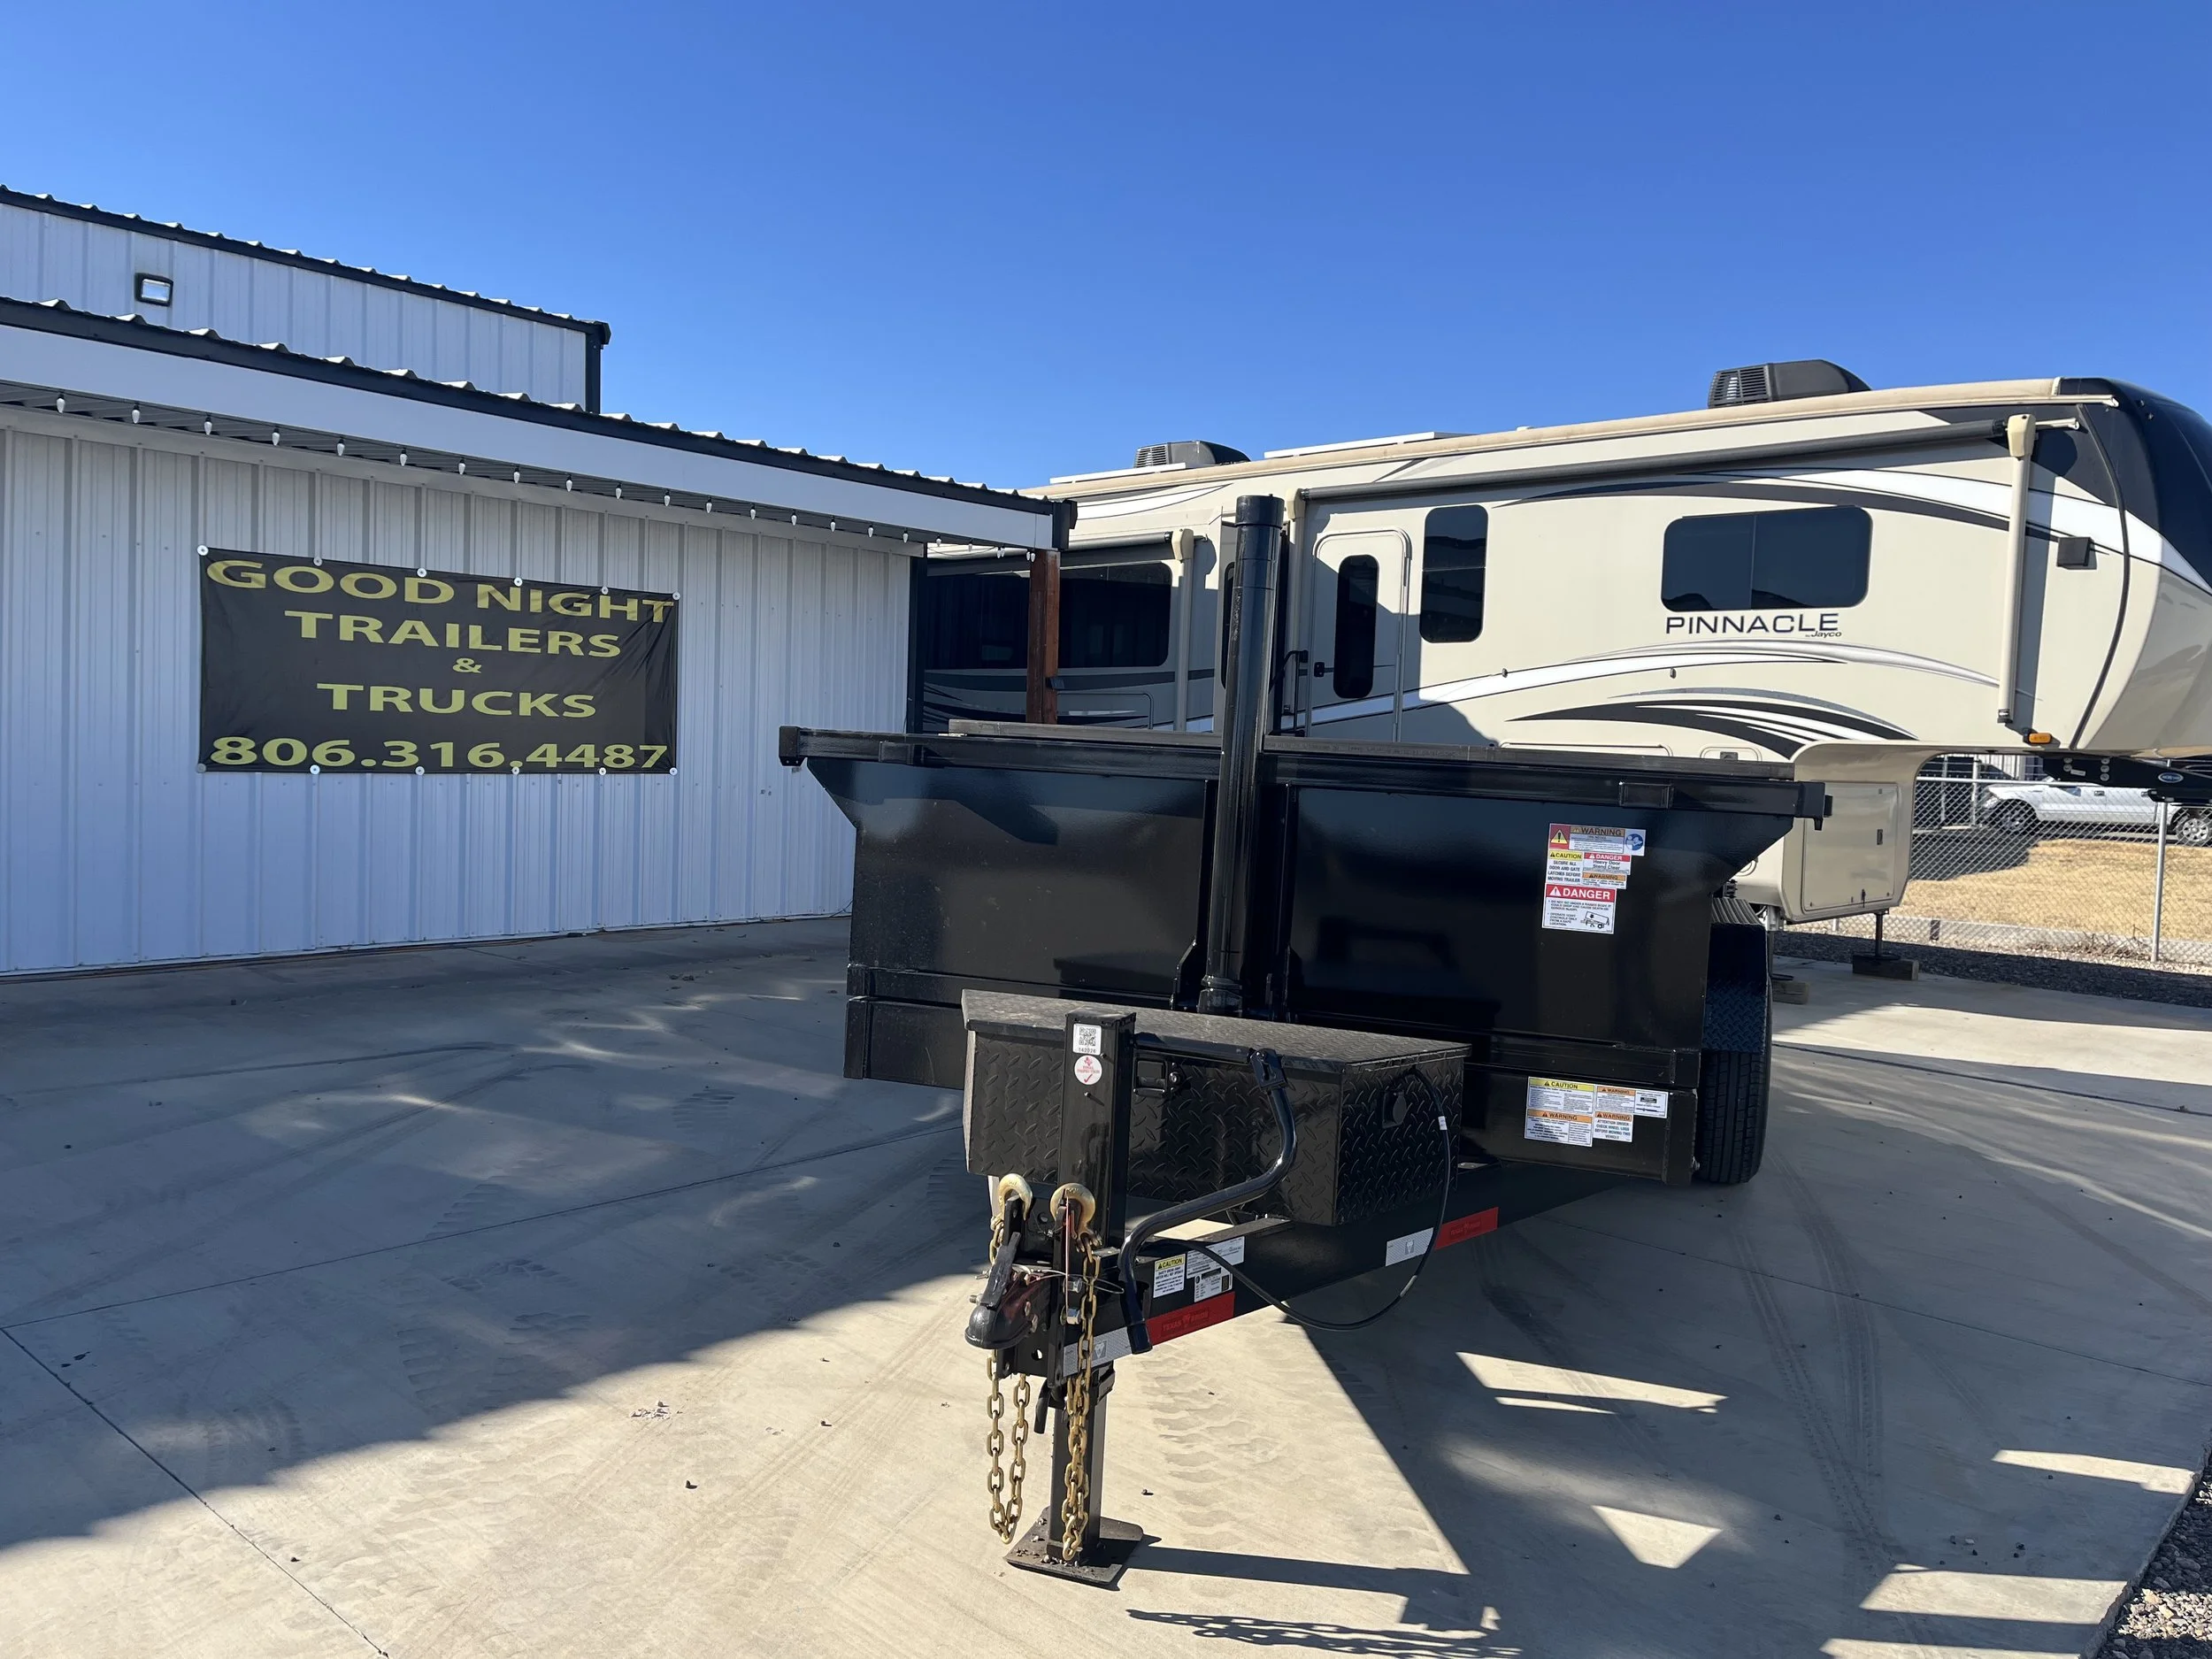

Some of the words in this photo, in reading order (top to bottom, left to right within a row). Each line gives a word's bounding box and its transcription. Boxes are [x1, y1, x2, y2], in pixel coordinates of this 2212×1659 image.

[207, 560, 454, 603] GOOD
[476, 585, 674, 623] NIGHT
[284, 611, 620, 657] TRAILERS
[1666, 613, 1839, 634] PINNACLE
[452, 657, 482, 673] &
[317, 683, 596, 718] TRUCKS
[210, 736, 668, 769] 806.316.4487
[1563, 888, 1610, 900] DANGER
[1163, 1258, 1182, 1267] CAUTION
